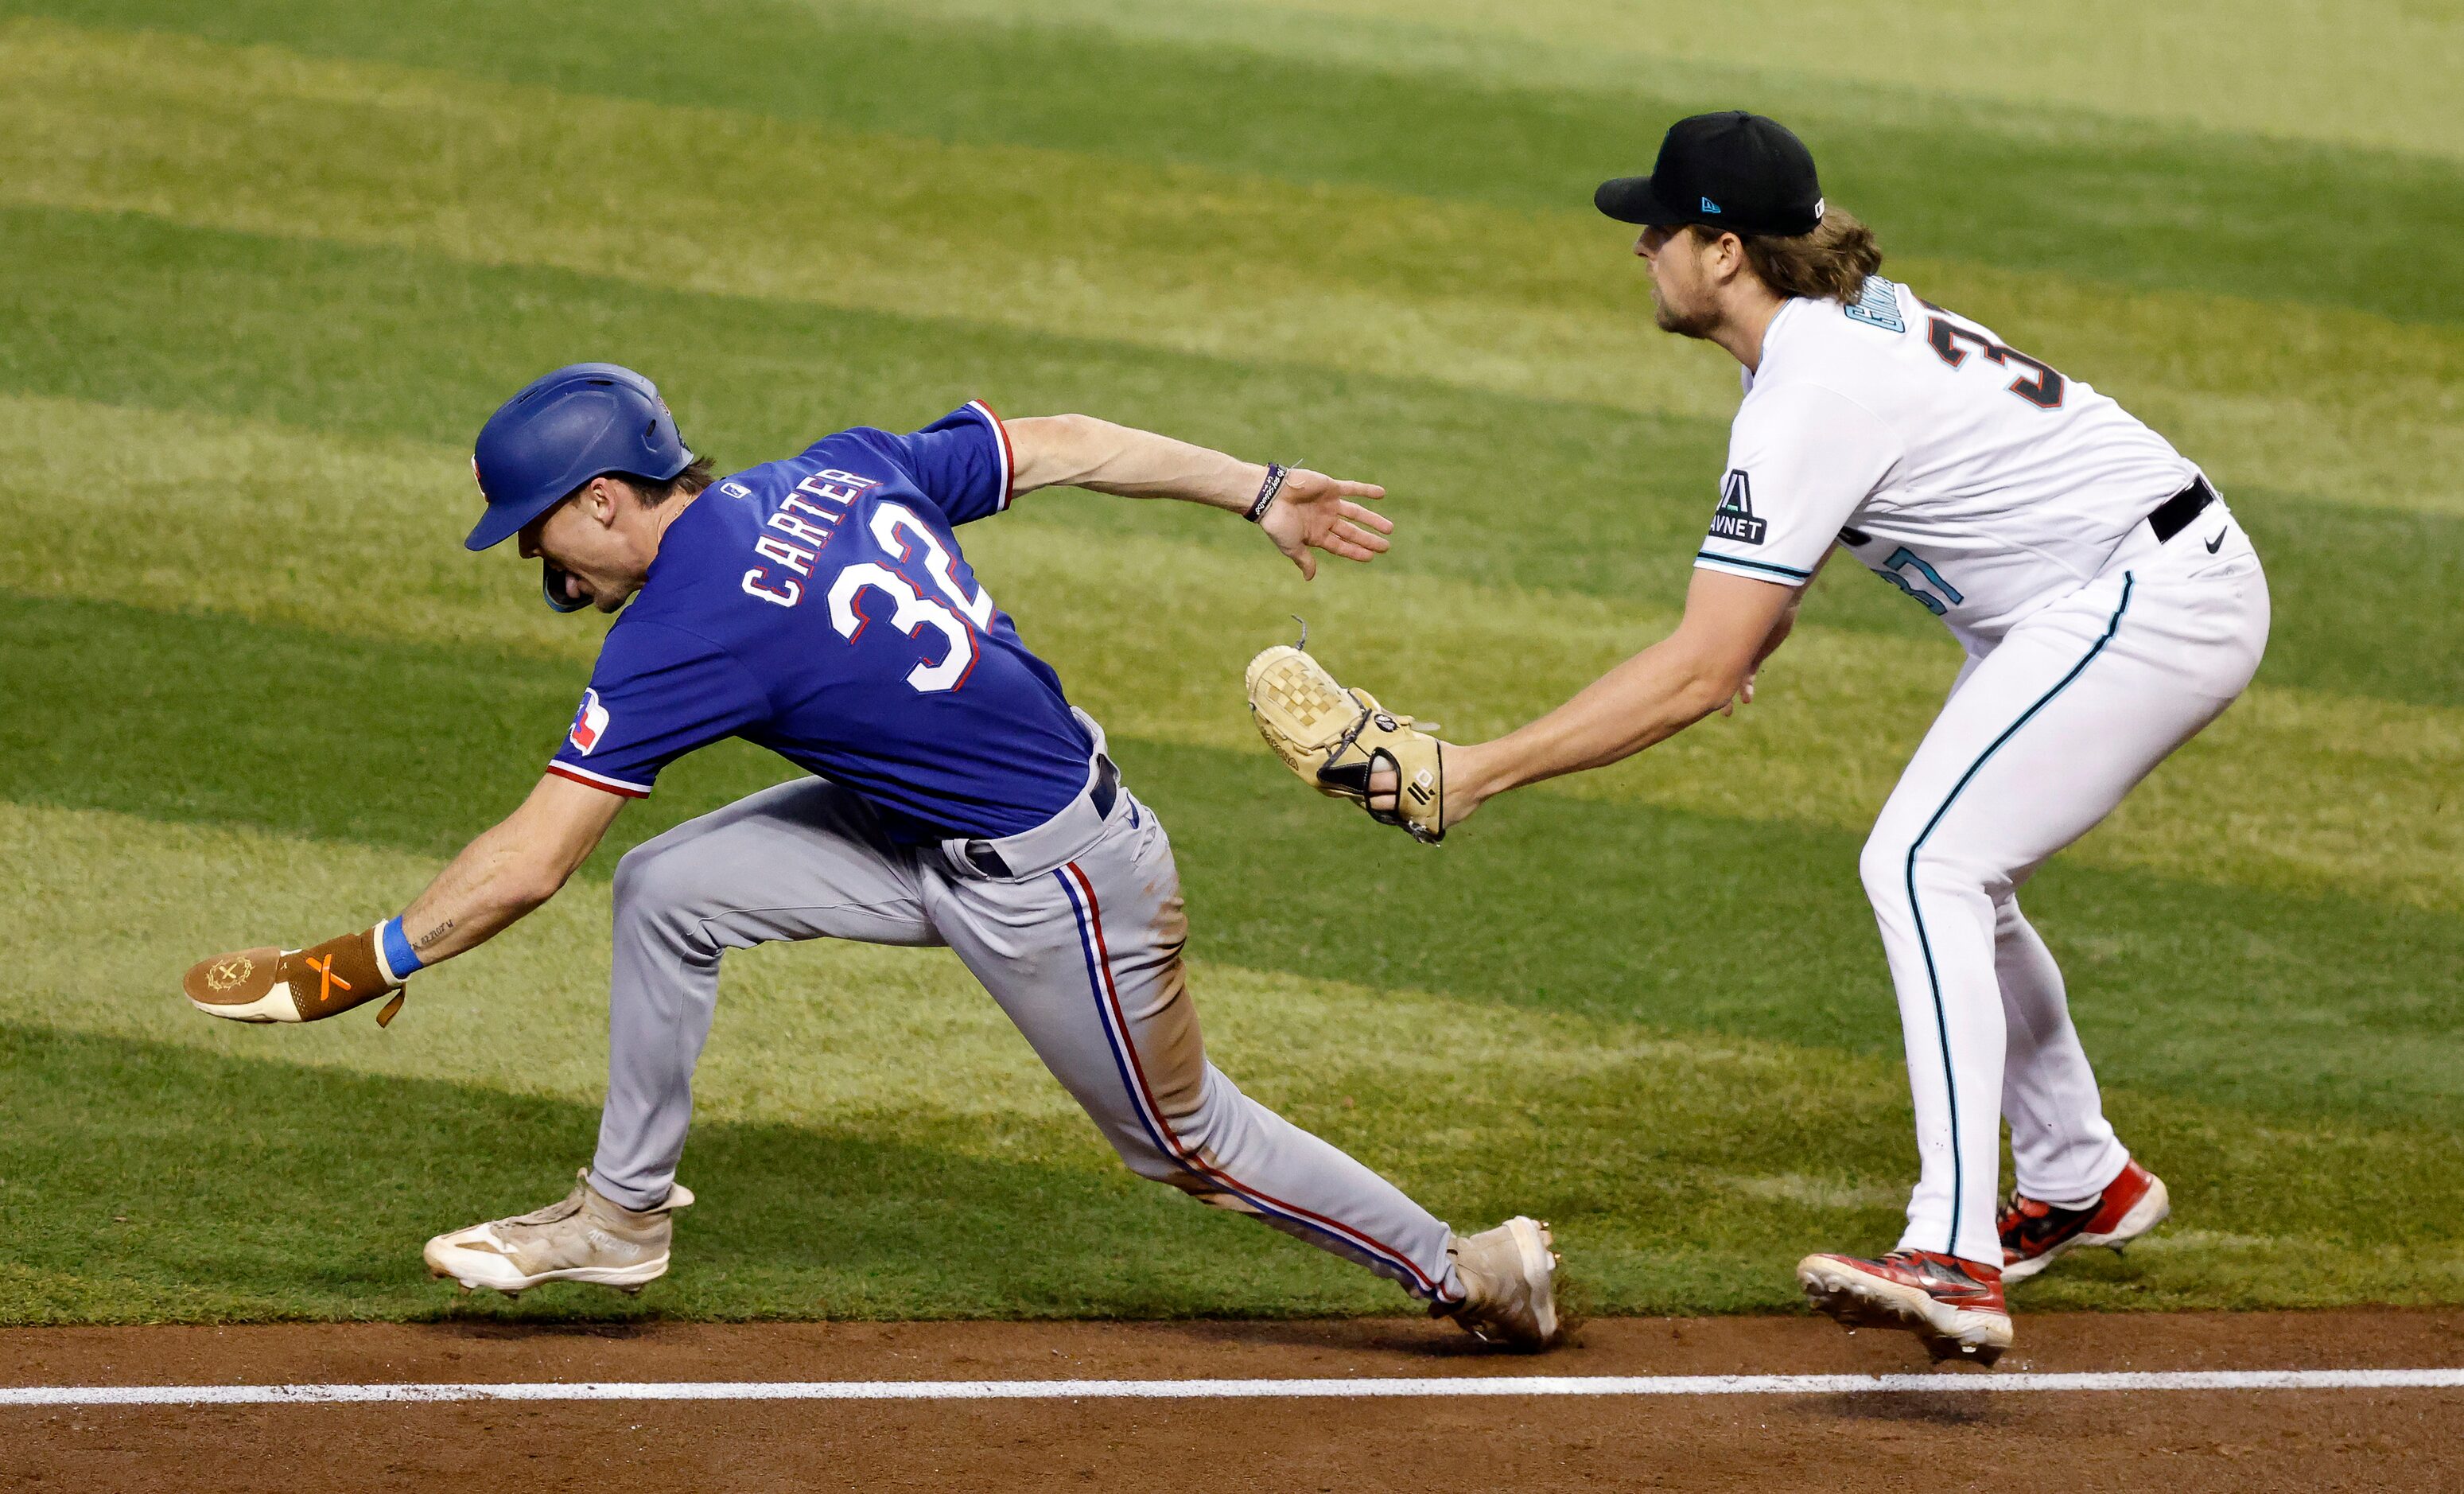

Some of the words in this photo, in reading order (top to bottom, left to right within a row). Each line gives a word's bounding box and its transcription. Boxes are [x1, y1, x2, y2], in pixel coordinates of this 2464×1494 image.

[741, 468, 883, 608] CARTER
[1710, 514, 1762, 540] AVNET
[824, 501, 997, 695] 32
